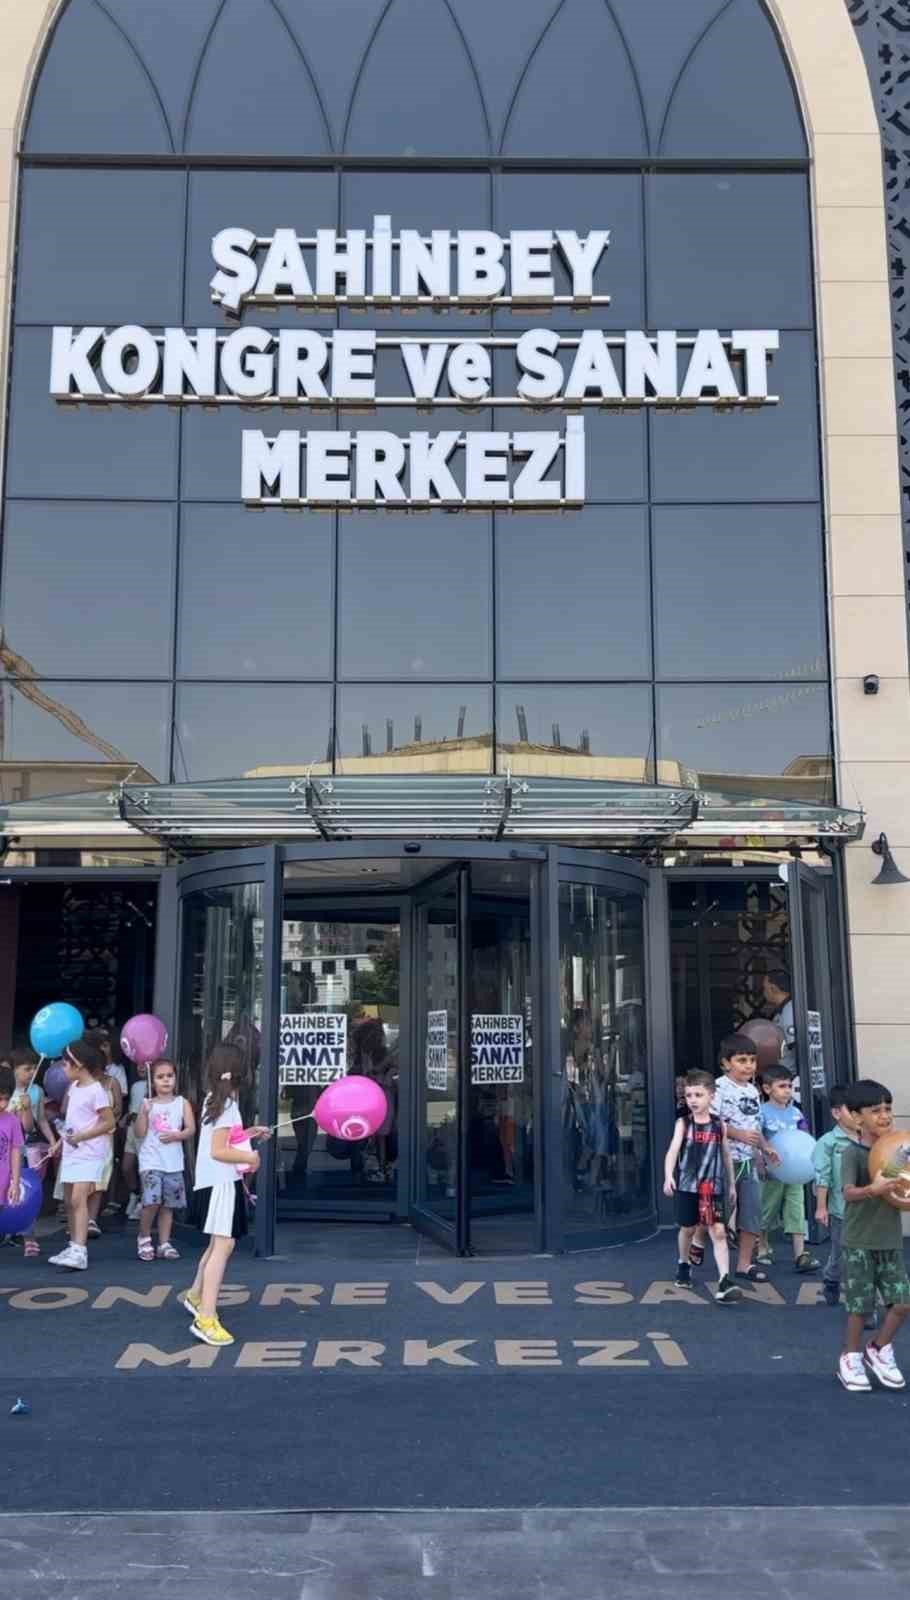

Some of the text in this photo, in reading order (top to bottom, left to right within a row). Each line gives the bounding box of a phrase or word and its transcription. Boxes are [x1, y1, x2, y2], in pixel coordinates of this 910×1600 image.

[210, 215, 610, 313] ŞAHİNBEY
[50, 325, 780, 401] KONGRE ve SANAT
[241, 415, 585, 502] MERKEZİ
[0, 1282, 390, 1310] ONGRE
[414, 1280, 553, 1305] VE
[115, 1331, 688, 1369] MERKEZİ
